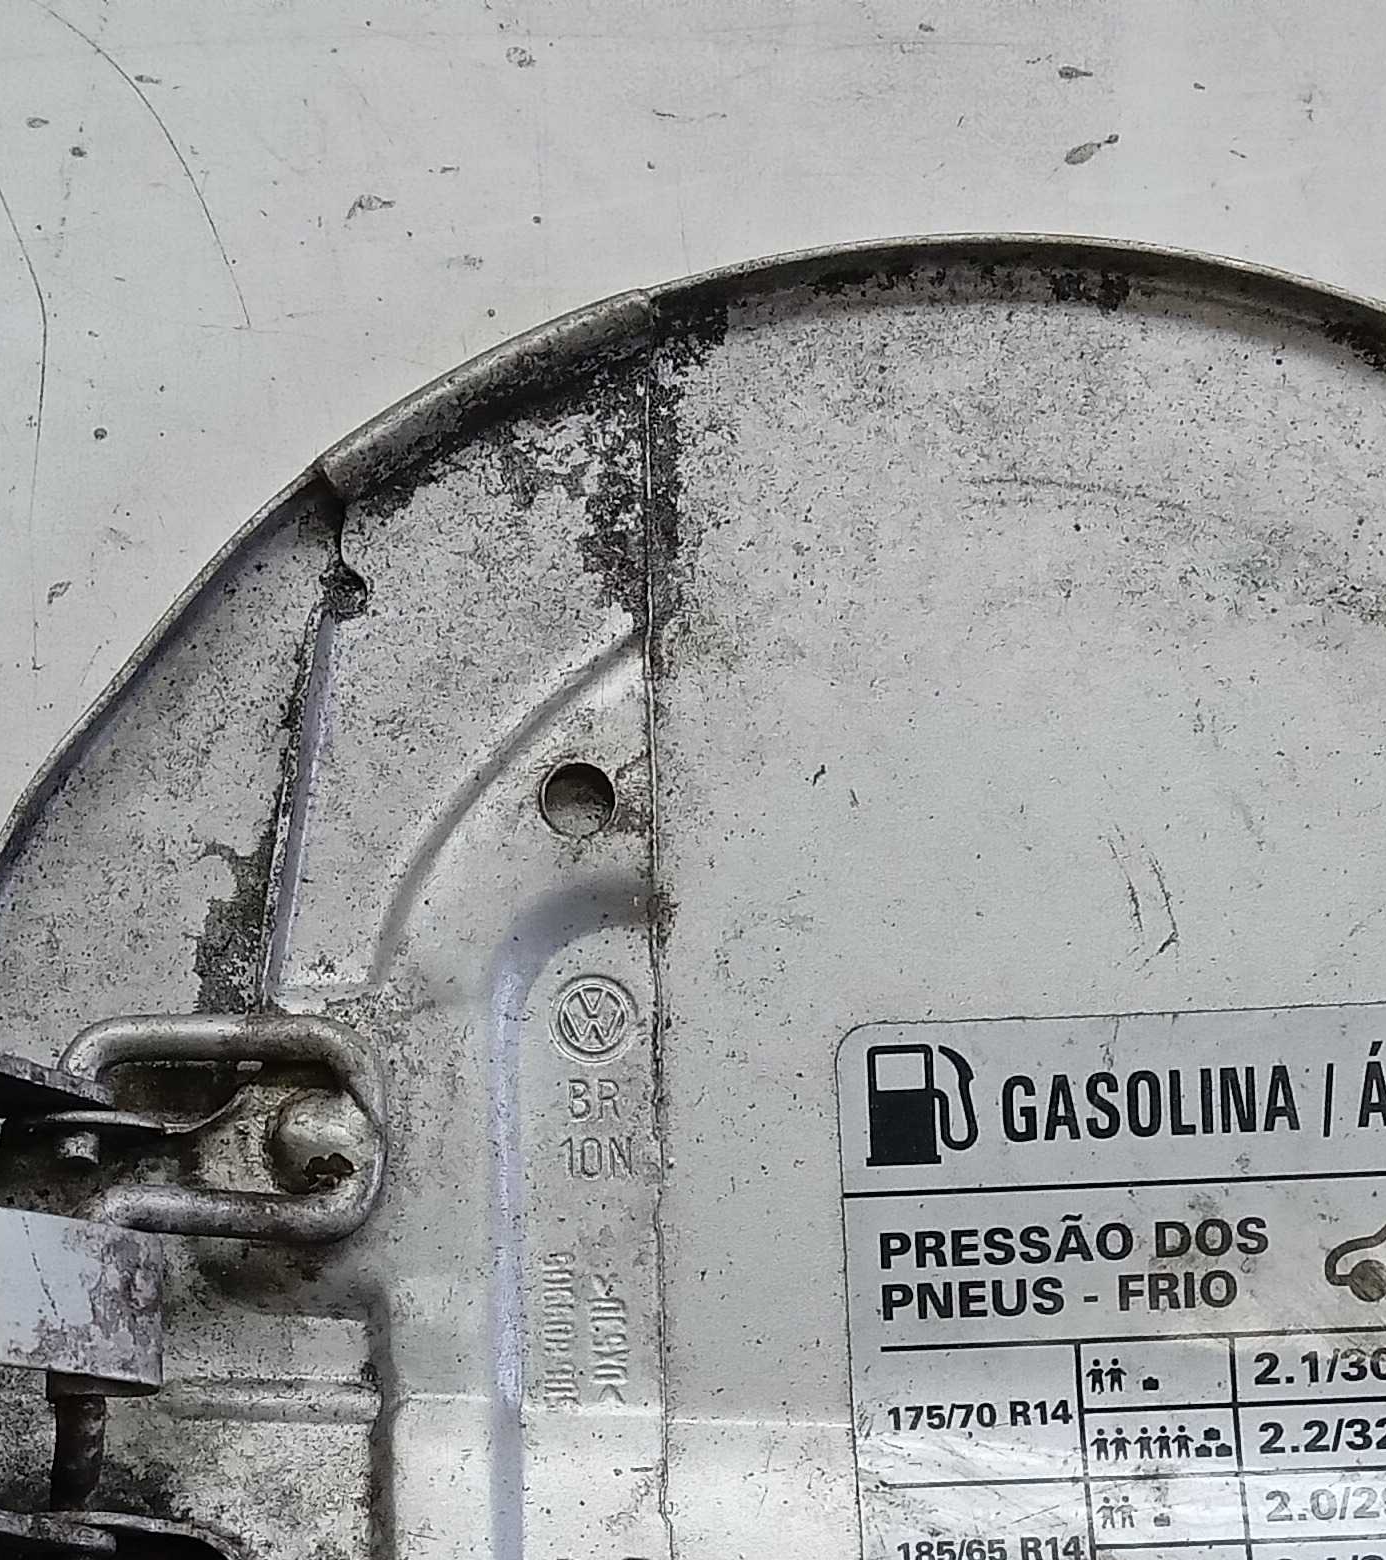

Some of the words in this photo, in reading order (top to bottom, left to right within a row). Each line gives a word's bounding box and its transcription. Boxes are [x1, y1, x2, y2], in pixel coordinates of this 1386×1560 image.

[568, 1078, 621, 1122] BR
[1001, 1064, 1300, 1142] GASOLINA
[1321, 1062, 1335, 1138] /
[559, 1136, 633, 1181] 10N
[879, 1214, 1134, 1269] PRESSÃO
[1154, 1217, 1269, 1257] DOS
[881, 1275, 1065, 1321] PNEUS
[1118, 1269, 1239, 1310] FRIO
[888, 1402, 997, 1431] 175/70
[1010, 1399, 1073, 1428] R14
